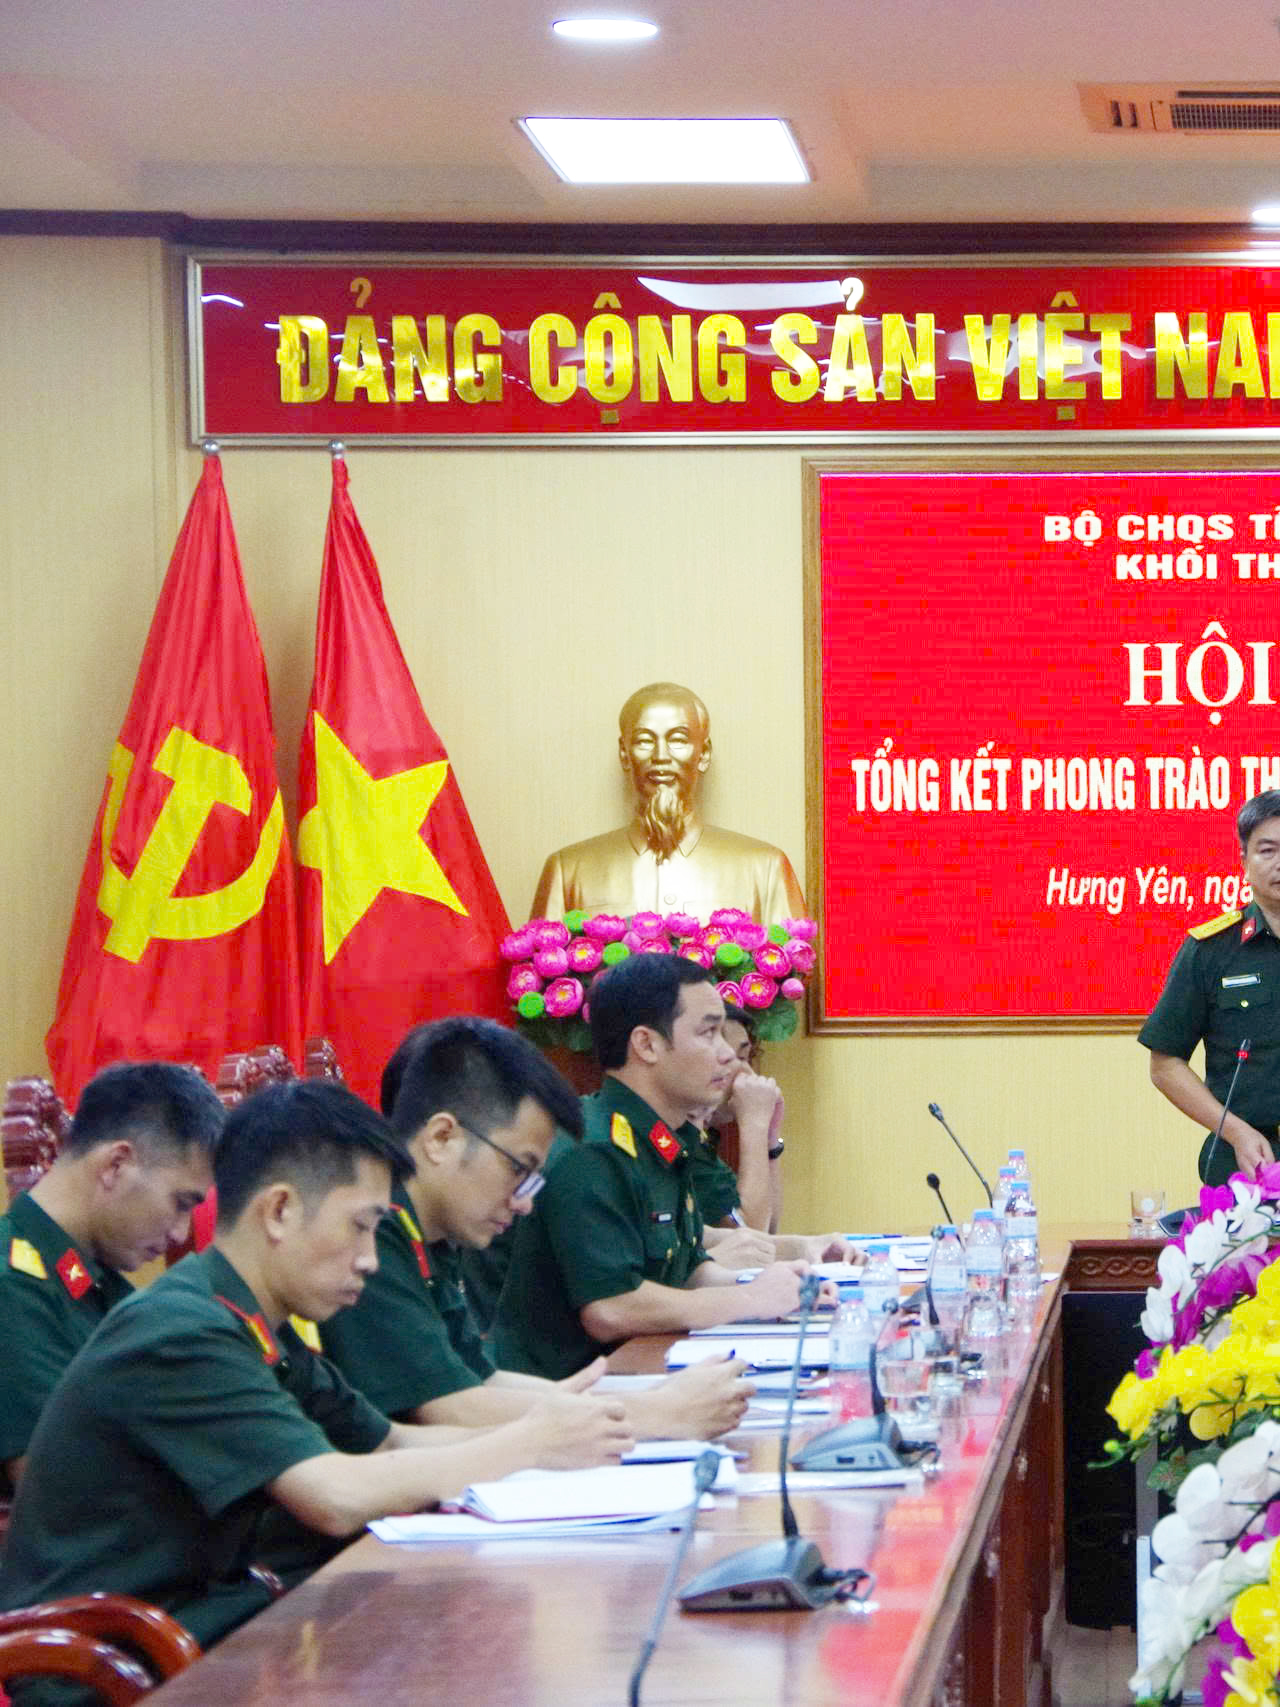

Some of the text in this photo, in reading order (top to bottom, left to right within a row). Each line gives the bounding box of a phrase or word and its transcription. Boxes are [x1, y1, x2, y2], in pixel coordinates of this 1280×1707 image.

[276, 277, 503, 403] ĐẢNG
[529, 291, 747, 425] CỘNG
[771, 277, 937, 402] SẢN
[963, 291, 1132, 421] VIỆT
[1044, 510, 1102, 547] BỘ
[1117, 514, 1235, 544] CHQS
[1116, 545, 1218, 580] KHỐI
[1122, 621, 1278, 726] HỘI
[851, 737, 940, 812] TỔNG
[951, 741, 1012, 811] KẾT
[1021, 757, 1136, 811] PHONG
[1145, 745, 1231, 810] TRÀO
[1046, 867, 1126, 914] Hưng
[1136, 866, 1195, 912] Yên,
